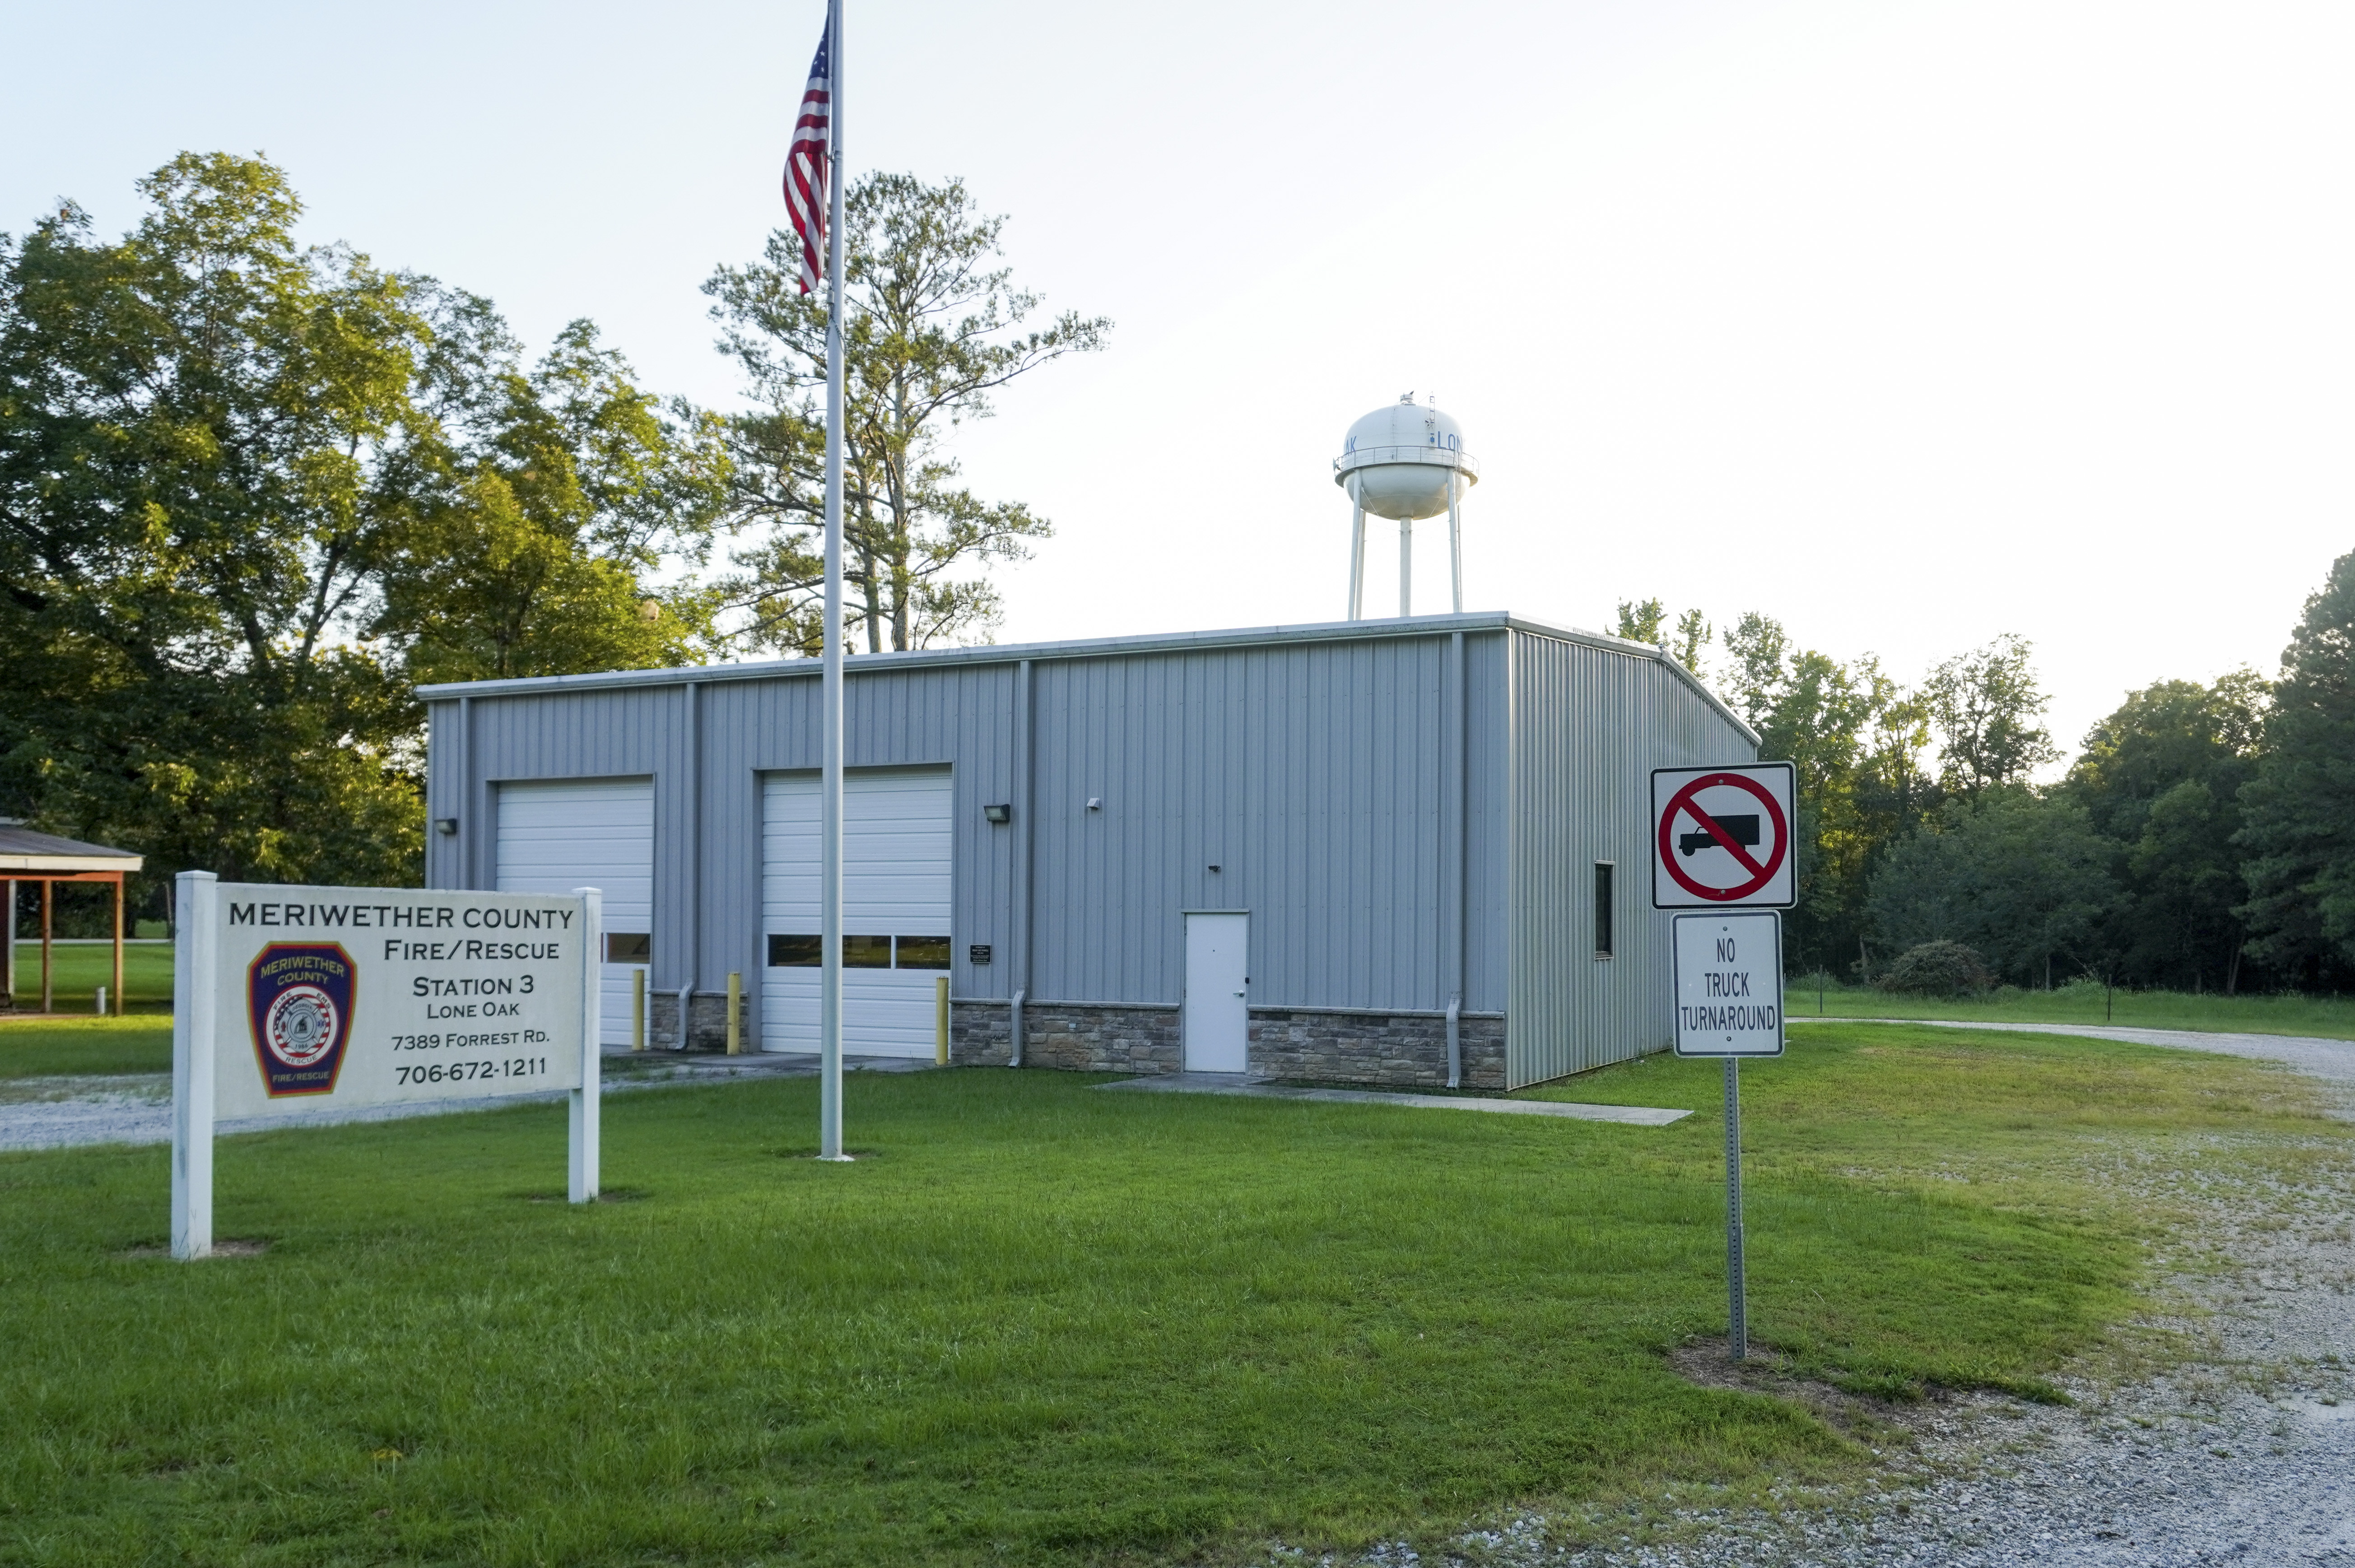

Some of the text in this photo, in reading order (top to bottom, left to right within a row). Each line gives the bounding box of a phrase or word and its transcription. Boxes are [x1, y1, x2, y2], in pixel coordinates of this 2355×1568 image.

[1345, 436, 1357, 456] AK
[229, 902, 574, 930] MERIWETHER COUNTY
[384, 939, 559, 961] FIRE/RESCUE
[1717, 938, 1736, 963] NO
[261, 956, 345, 979] MERIWETHER
[277, 971, 329, 985] COUNTY
[413, 975, 534, 997] STATION 3
[1704, 972, 1750, 997] TRUCK
[273, 991, 331, 1010] FIRE EMS
[427, 1001, 520, 1019] LONE OAK
[1681, 1005, 1775, 1031] TURNAROUND
[391, 1029, 550, 1051] 7389 FORREST RD.
[285, 1055, 317, 1064] RESCUE
[272, 1070, 329, 1083] FIRE/RESCUE
[396, 1057, 546, 1085] 706-672-1211
